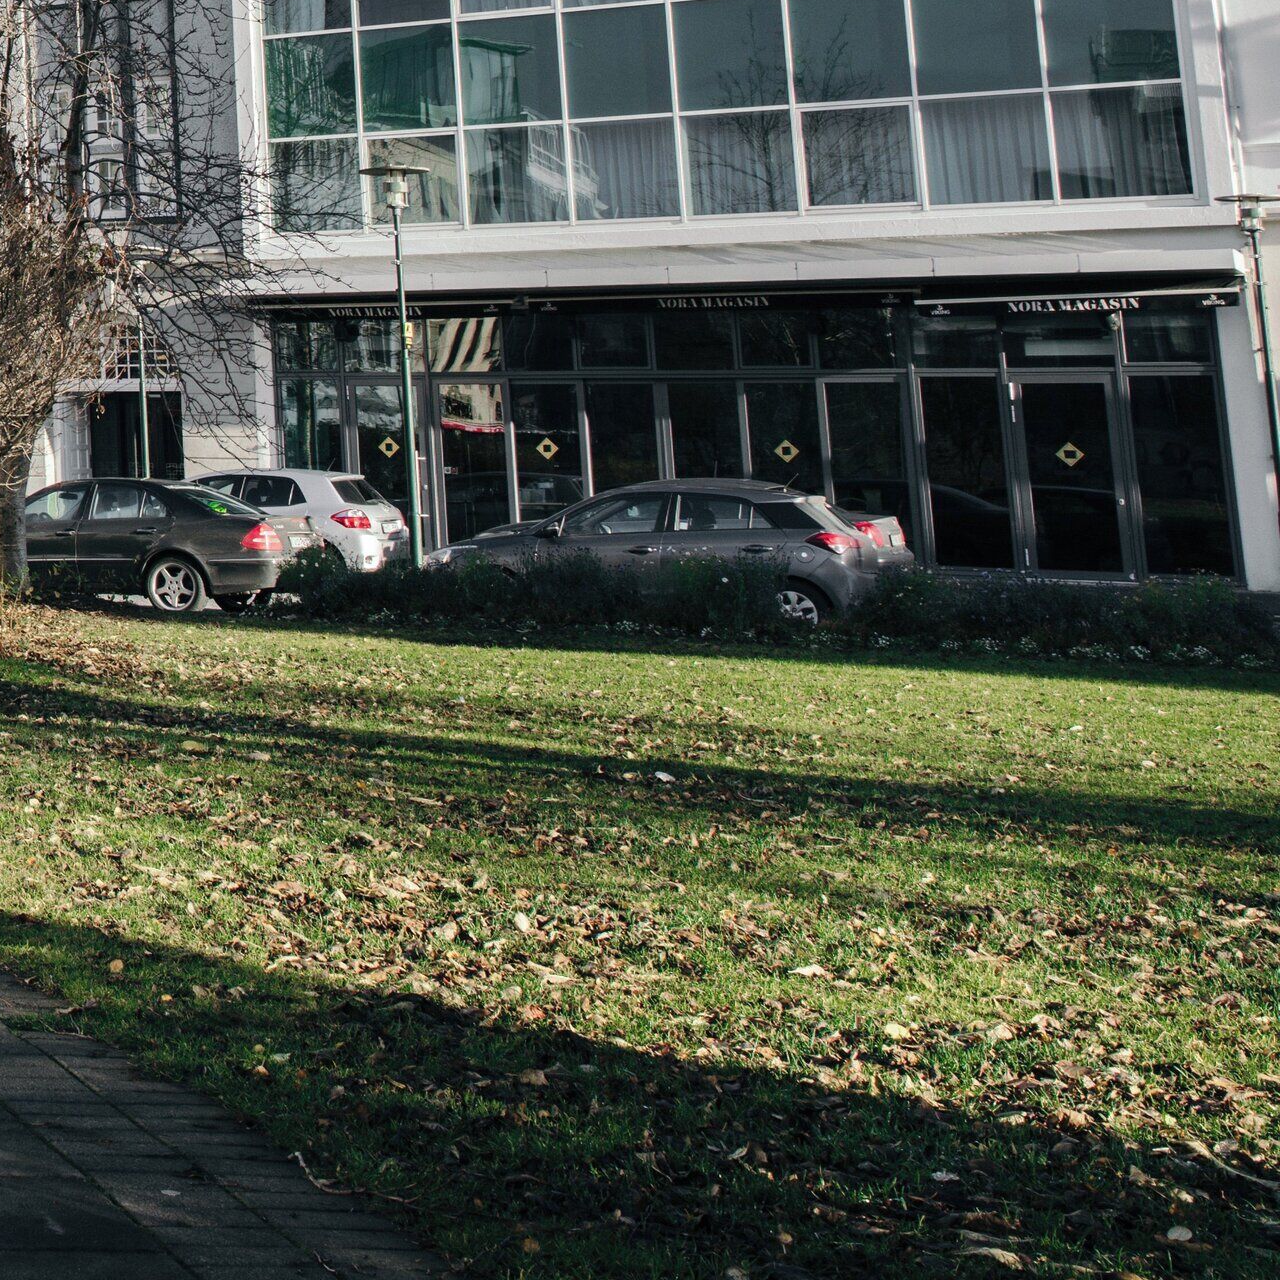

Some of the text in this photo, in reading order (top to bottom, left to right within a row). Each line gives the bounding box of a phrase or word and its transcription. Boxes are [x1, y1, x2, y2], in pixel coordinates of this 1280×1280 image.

[658, 296, 769, 308] NORA MAGASIN
[1007, 297, 1140, 313] NORA MAGASIN
[328, 308, 362, 318] NORA
